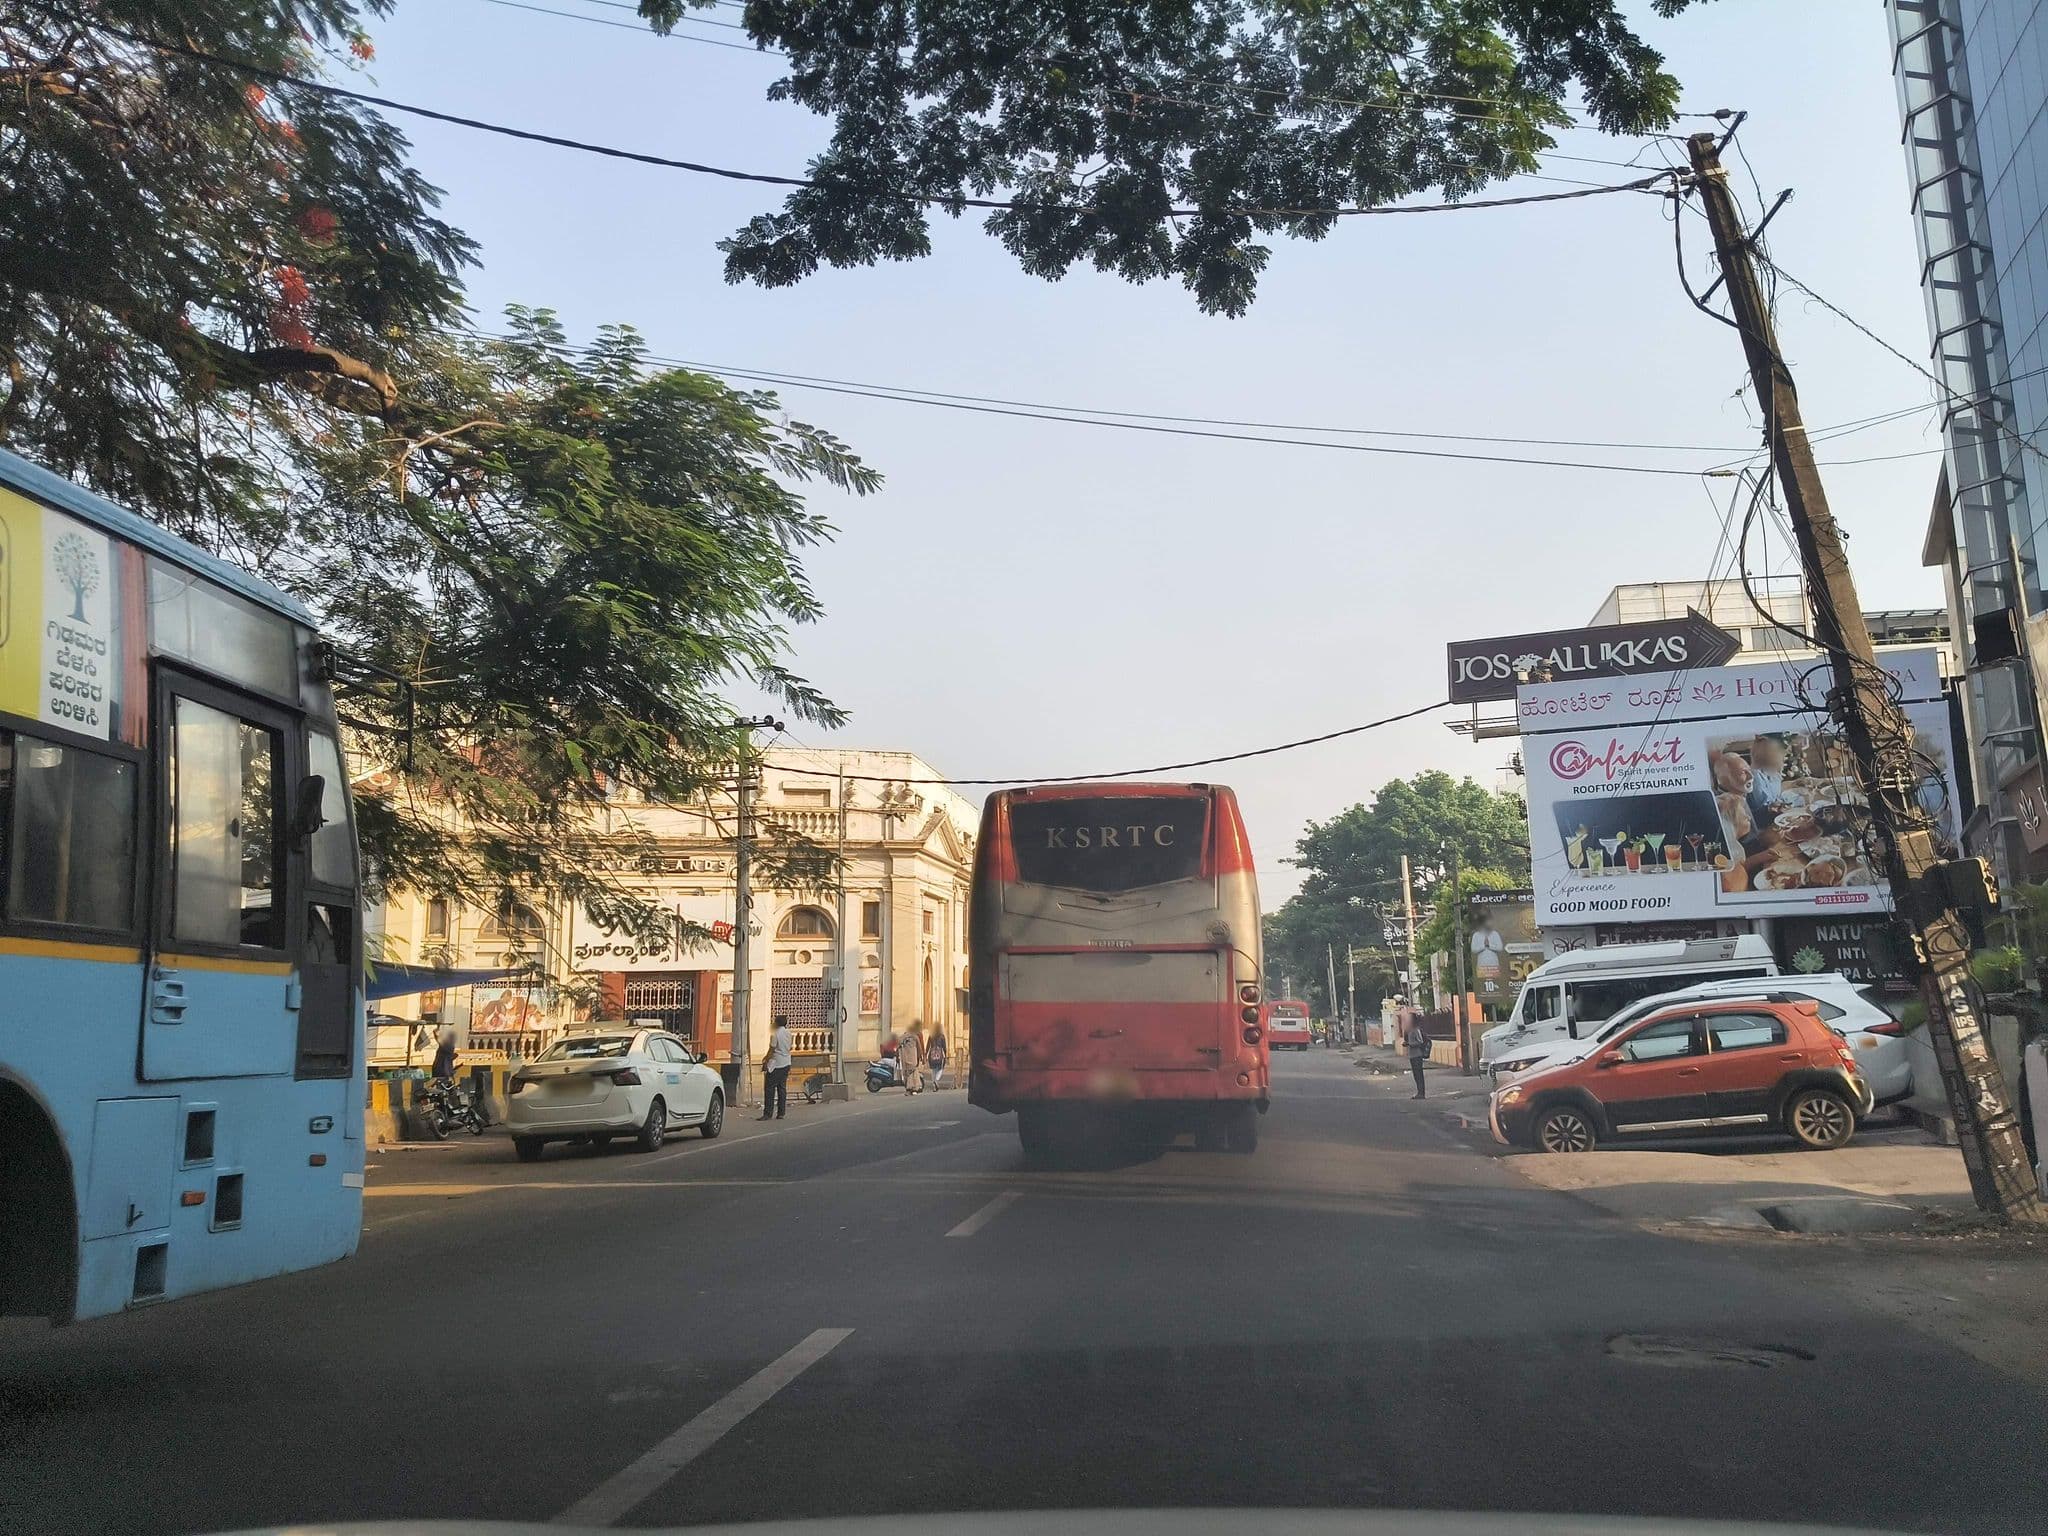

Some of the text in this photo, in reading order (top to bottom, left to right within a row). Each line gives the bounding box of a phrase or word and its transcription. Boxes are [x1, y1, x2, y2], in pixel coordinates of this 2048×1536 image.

[47, 621, 106, 656] ಗಿಡಮರ
[1454, 653, 1512, 684] JOS
[49, 671, 102, 702] ಪರಿಸರ
[51, 698, 99, 726] ಉಳಿಸಿ
[1520, 691, 1614, 717] ಹೋಟೆಲ್
[1645, 767, 1670, 775] never
[1673, 763, 1696, 772] ends
[1573, 777, 1689, 795] ROOFTOP RESTAURANT
[1046, 824, 1175, 849] KSRTC
[1549, 879, 1617, 898] Experience
[1550, 896, 1672, 914] GOOD MOOD FOOD!
[1954, 1014, 1976, 1029] IPS
